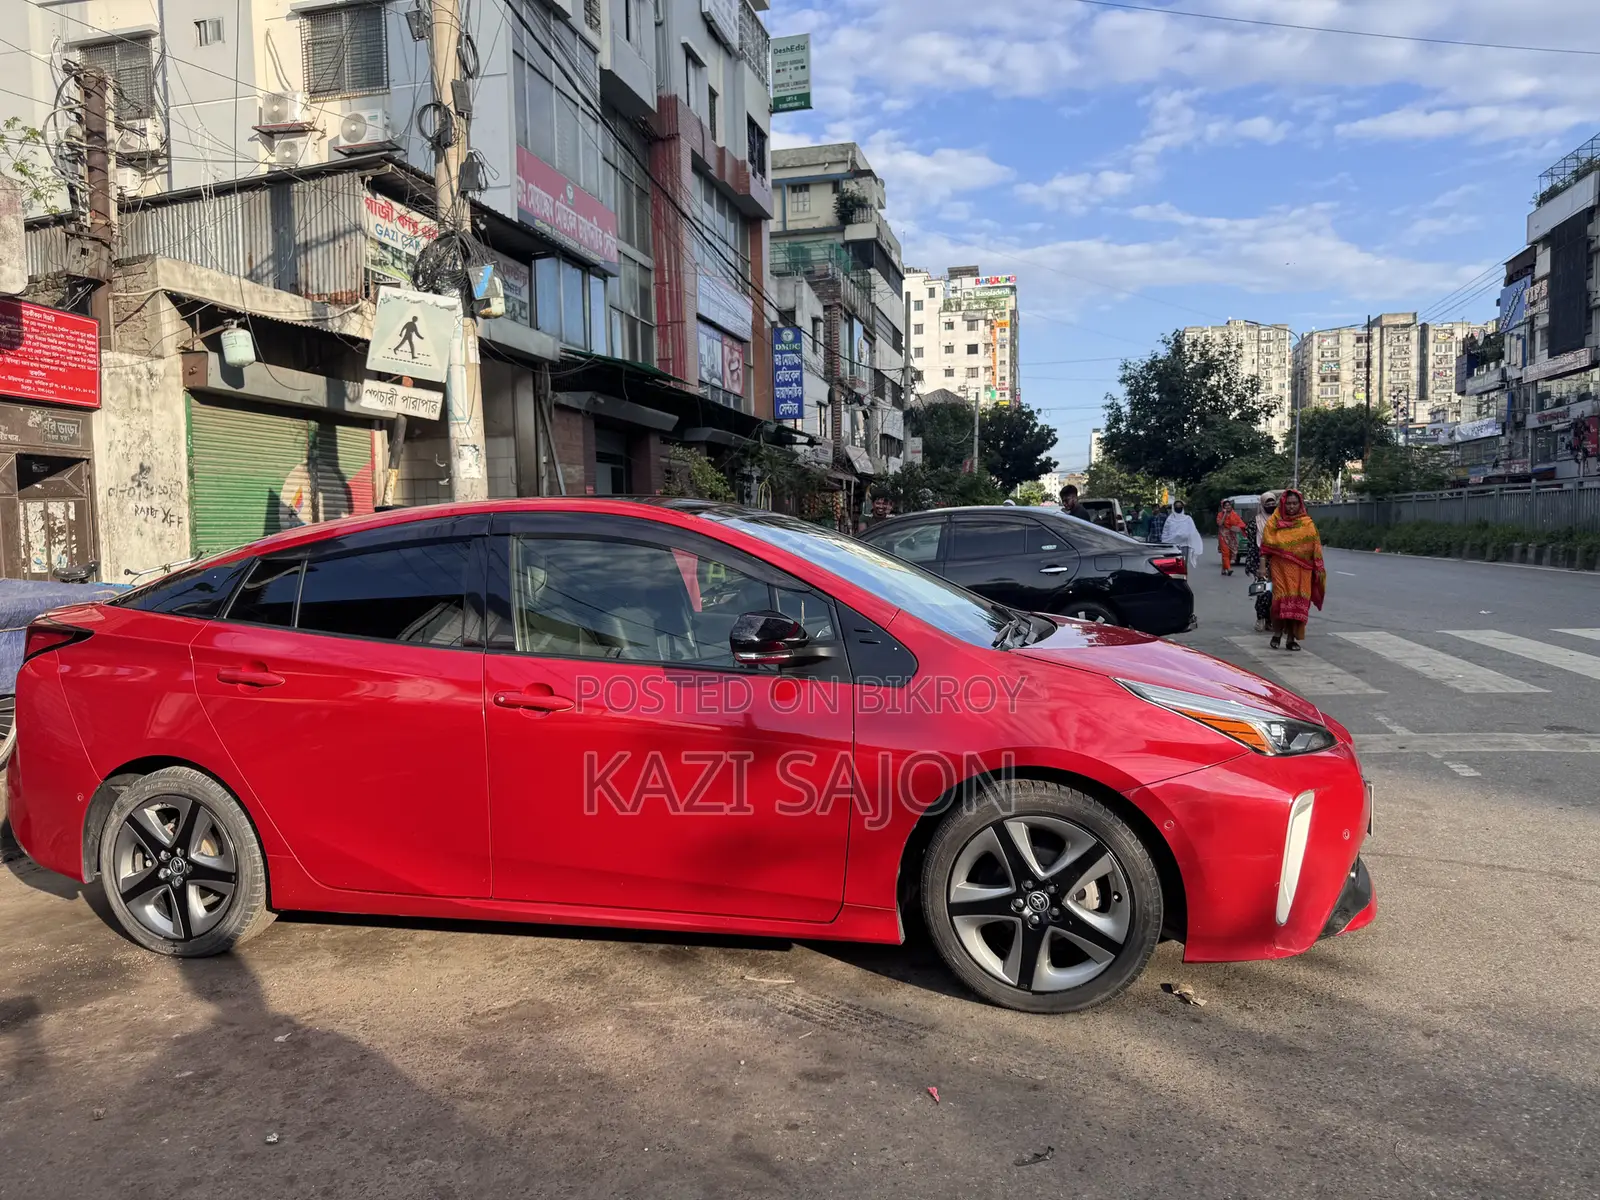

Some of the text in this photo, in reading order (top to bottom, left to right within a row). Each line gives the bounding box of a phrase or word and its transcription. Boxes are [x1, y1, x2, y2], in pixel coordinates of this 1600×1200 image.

[774, 44, 805, 54] DeshEdu
[364, 197, 394, 223] গাজী
[374, 223, 399, 243] GAZI
[775, 343, 801, 351] DMDC
[401, 394, 439, 414] পারাপার
[57, 421, 79, 437] ভাড়া
